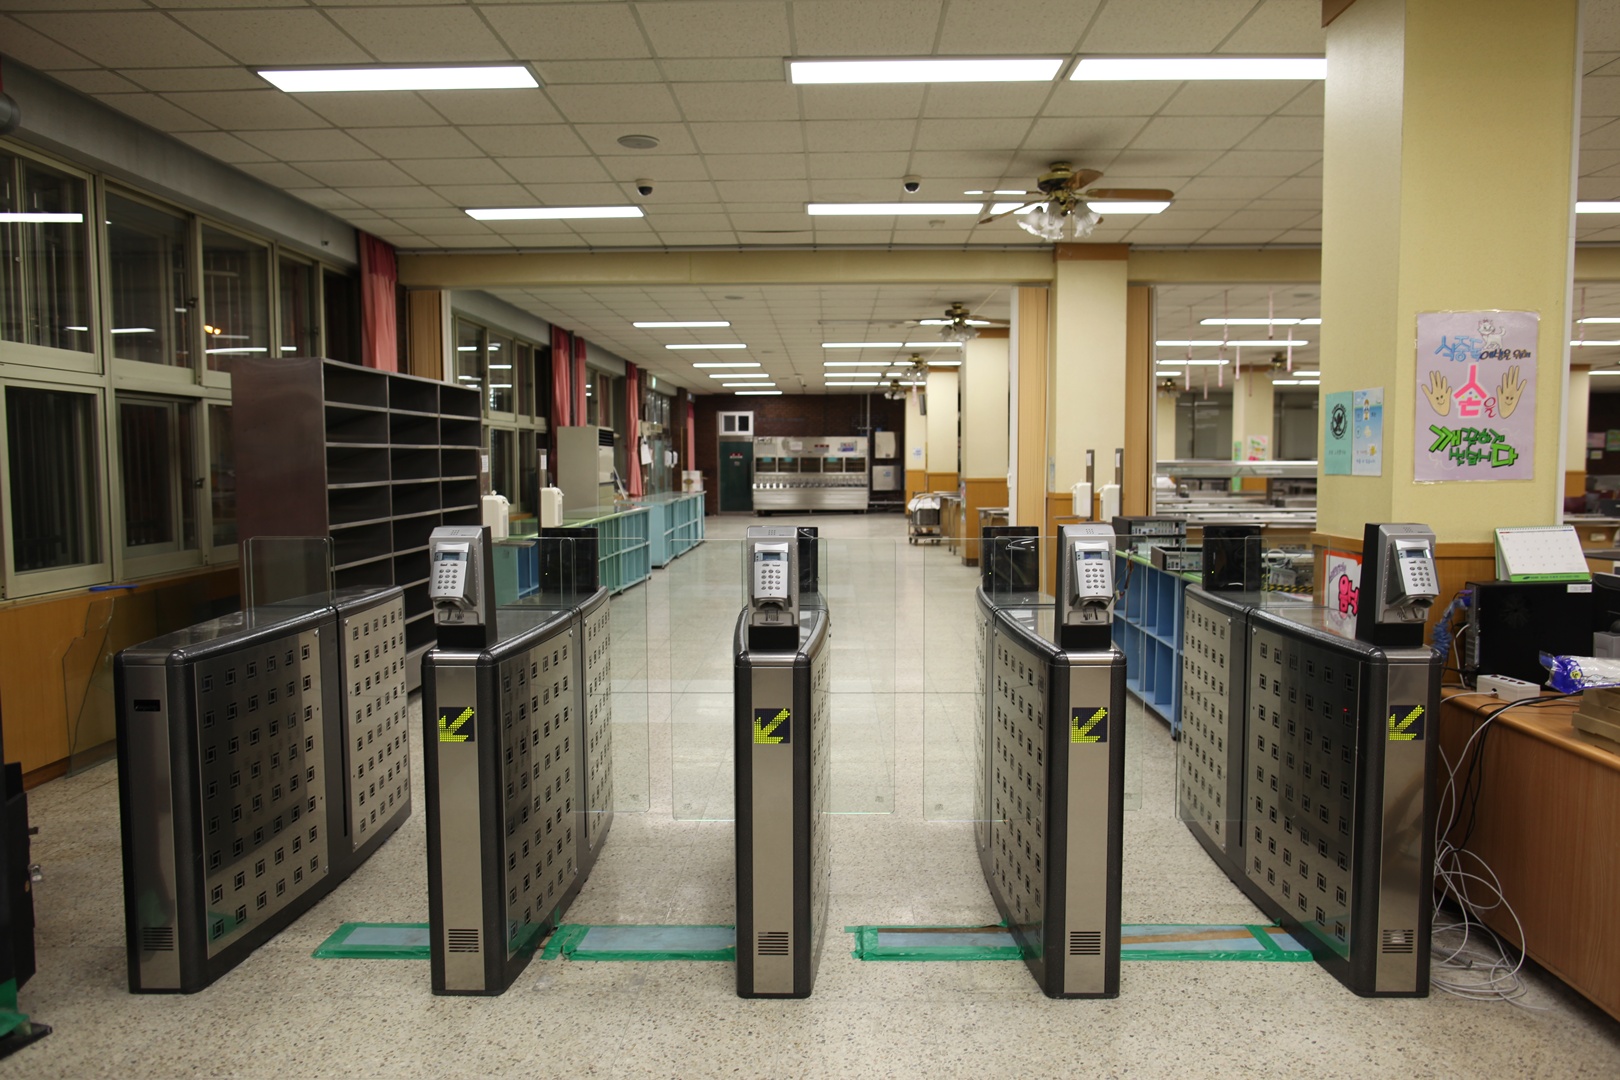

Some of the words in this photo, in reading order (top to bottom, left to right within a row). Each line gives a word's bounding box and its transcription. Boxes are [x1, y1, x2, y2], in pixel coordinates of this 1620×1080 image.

[1434, 335, 1483, 362] 식중독
[1479, 348, 1512, 361] 예방을
[1453, 364, 1497, 418] 손을
